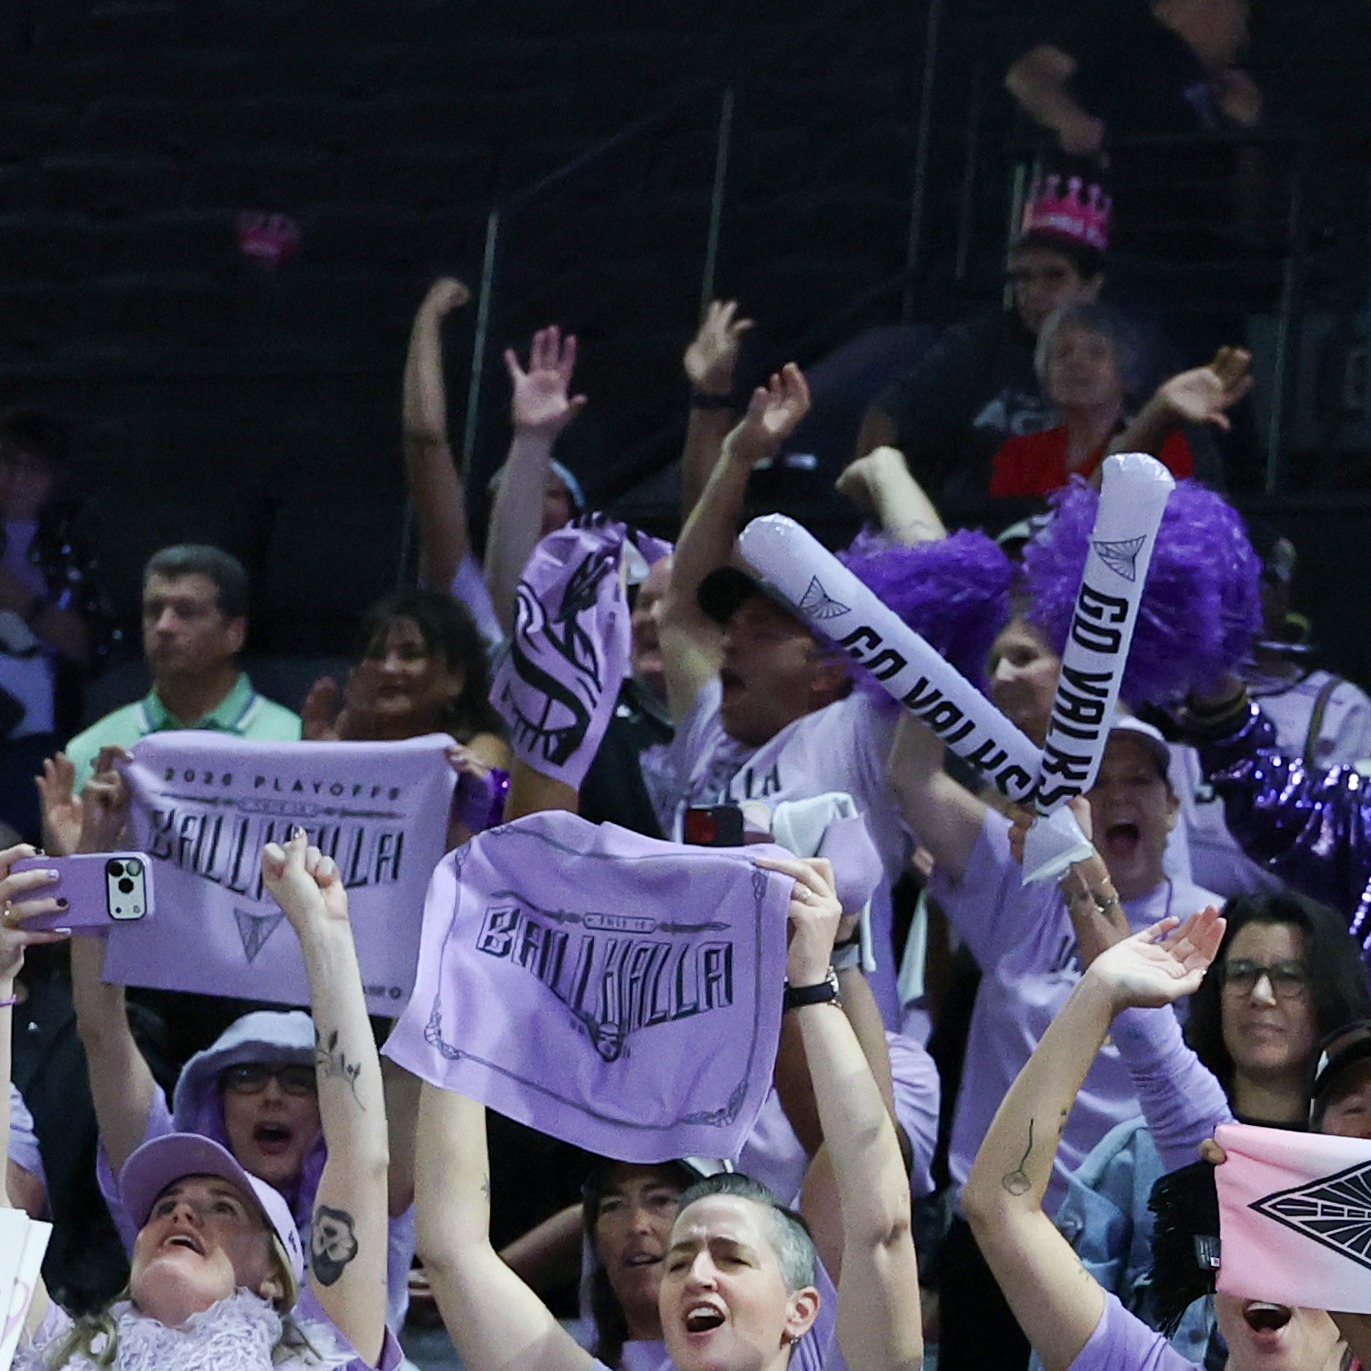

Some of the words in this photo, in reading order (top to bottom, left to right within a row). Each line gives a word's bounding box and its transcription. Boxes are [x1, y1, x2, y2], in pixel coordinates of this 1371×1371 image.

[1074, 582, 1129, 655] GO
[839, 625, 908, 681] GO
[254, 775, 401, 800] PLAYOFFS
[475, 903, 735, 1033] BALLHALLA
